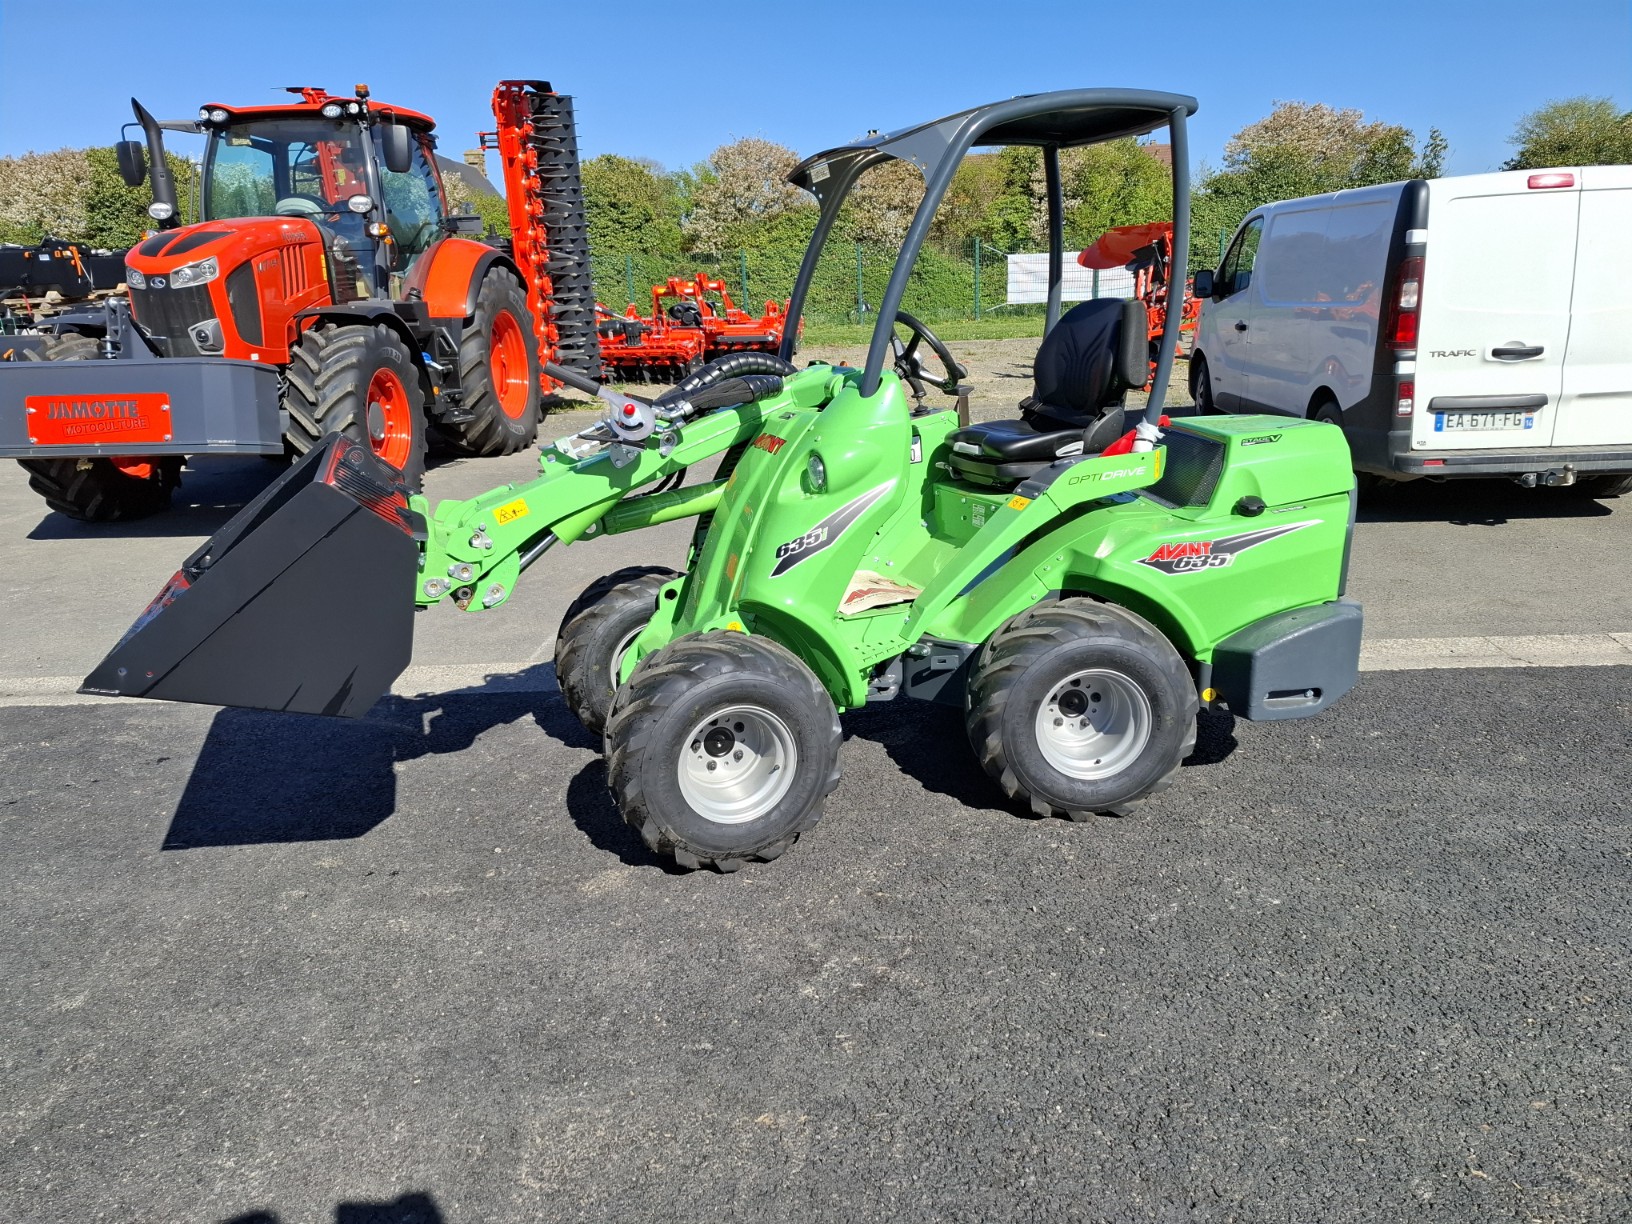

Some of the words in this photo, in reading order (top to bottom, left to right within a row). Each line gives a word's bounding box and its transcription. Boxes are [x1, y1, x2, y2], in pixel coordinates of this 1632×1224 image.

[1429, 350, 1476, 358] TRAFIC
[48, 401, 138, 419] JAMOTTE
[66, 418, 147, 435] MOTOCULTURE
[1445, 412, 1523, 428] EA-671-FG
[1068, 467, 1147, 485] OPTIDRIVE
[1145, 541, 1214, 562] AVANT
